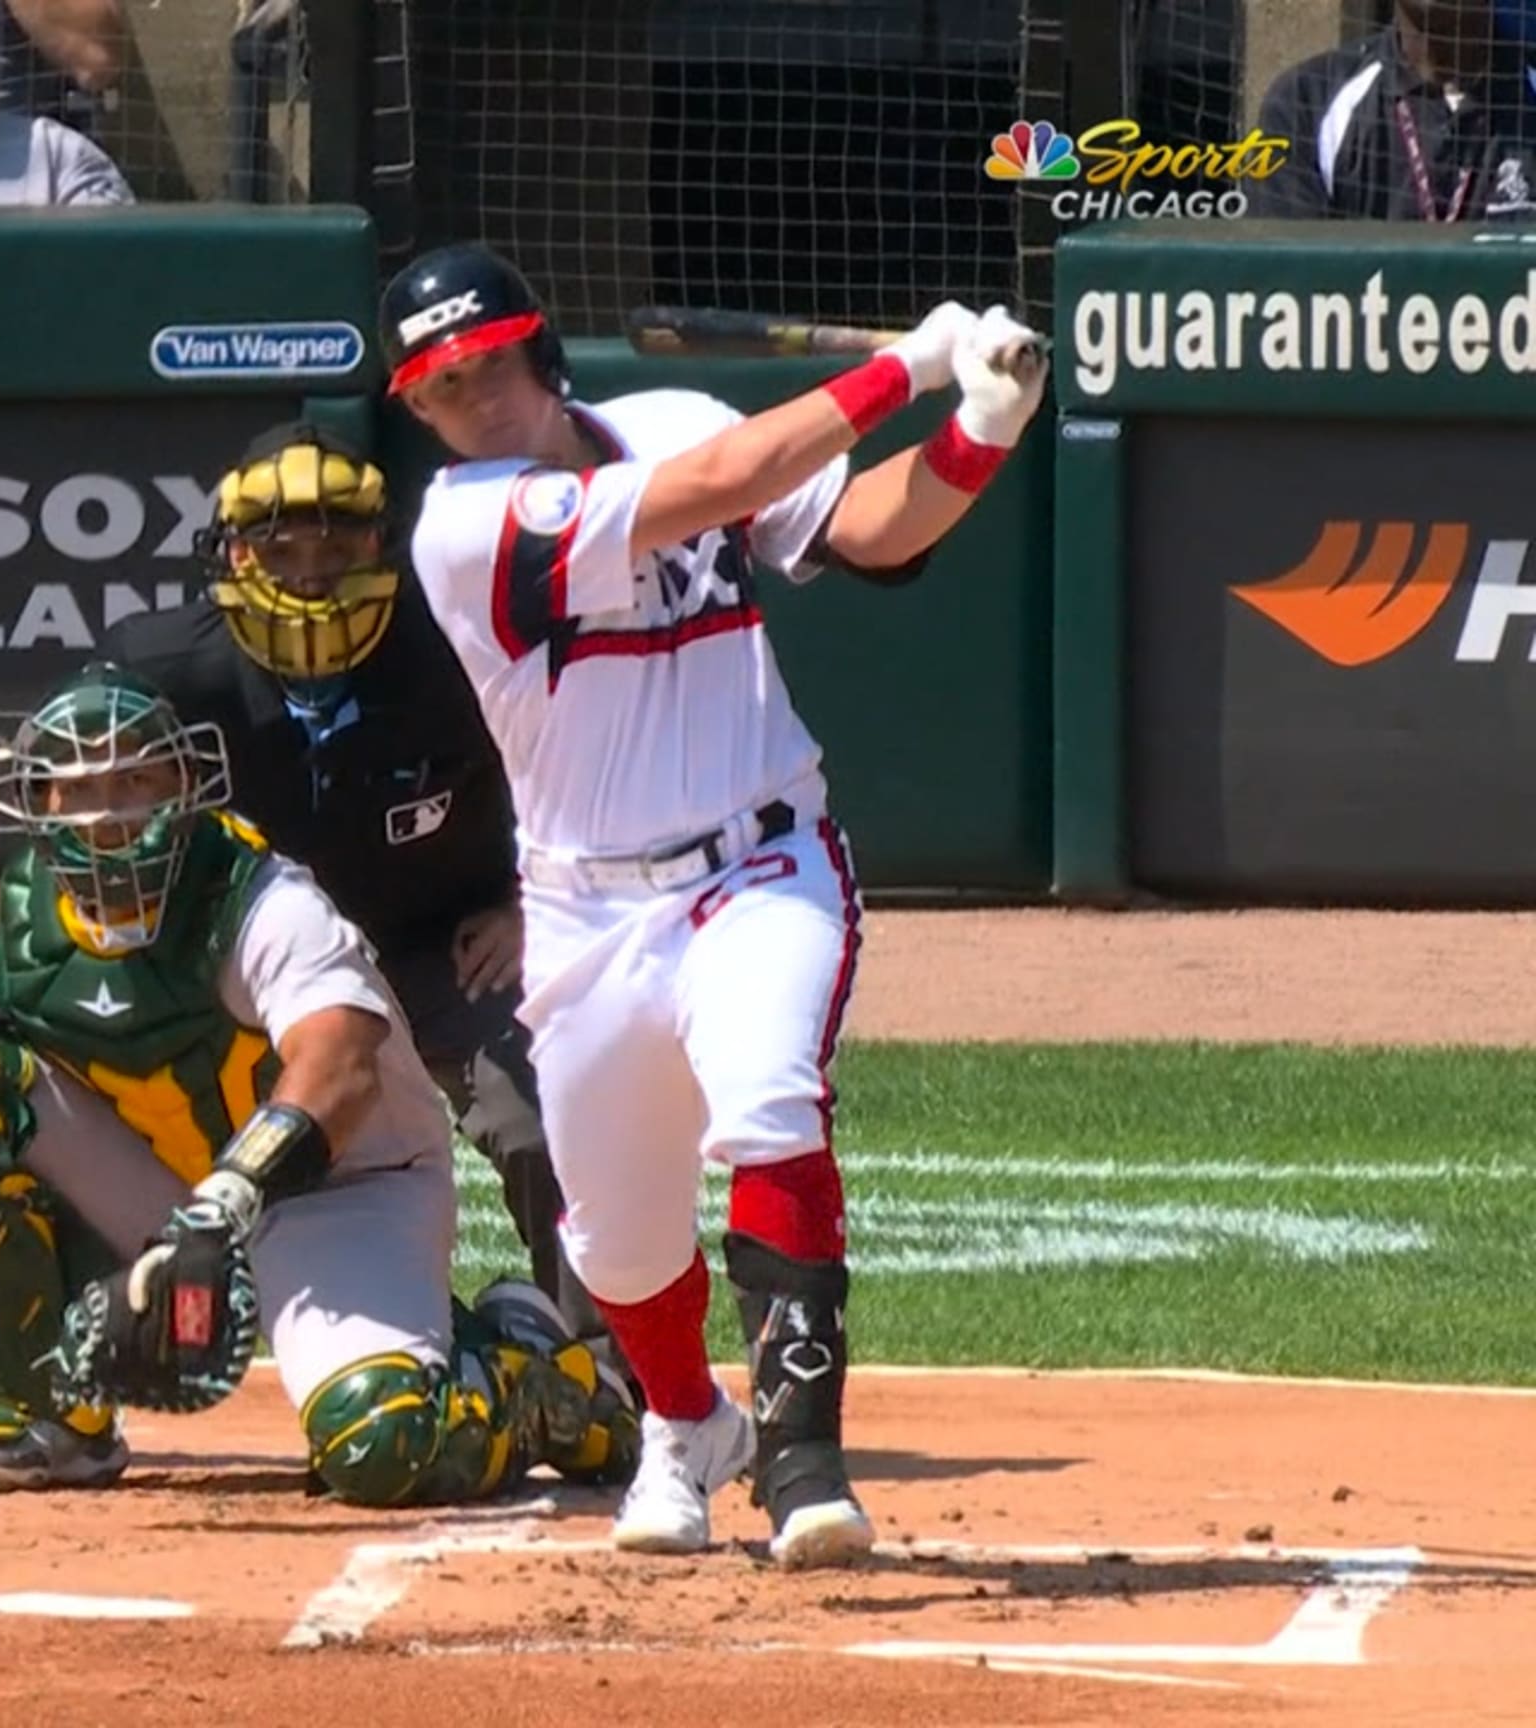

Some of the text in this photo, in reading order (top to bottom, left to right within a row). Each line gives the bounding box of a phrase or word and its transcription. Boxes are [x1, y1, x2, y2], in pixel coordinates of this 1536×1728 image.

[163, 332, 352, 368] Van Wagner
[1073, 269, 1536, 396] guaranteed
